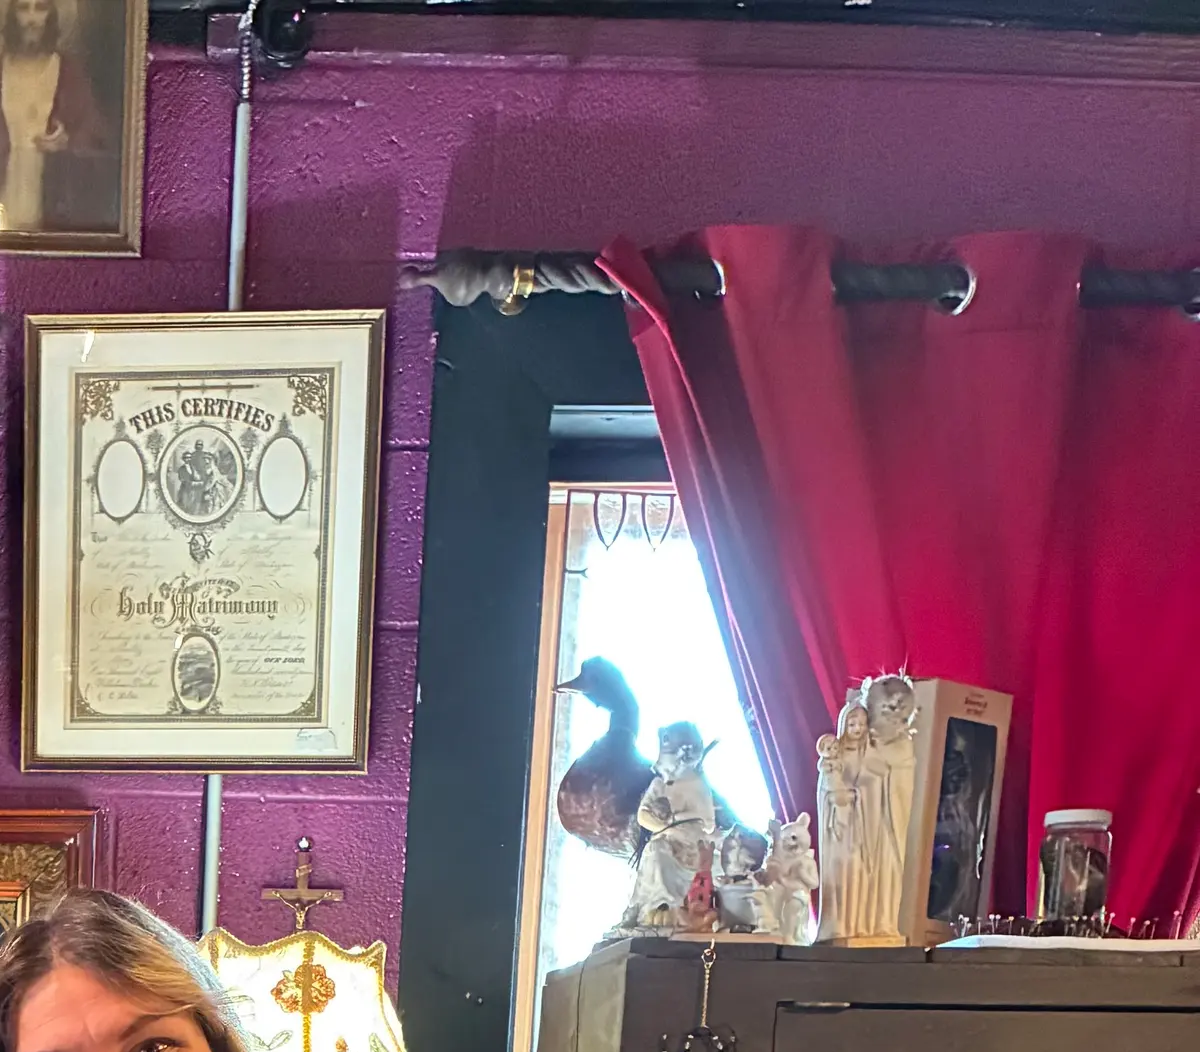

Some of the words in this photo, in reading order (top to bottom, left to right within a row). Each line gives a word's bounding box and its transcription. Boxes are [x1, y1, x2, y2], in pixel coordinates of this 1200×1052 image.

[129, 403, 175, 433] THIS
[181, 398, 275, 432] CERTIFIES
[117, 586, 164, 621] Holy
[164, 575, 279, 628] Matrimony
